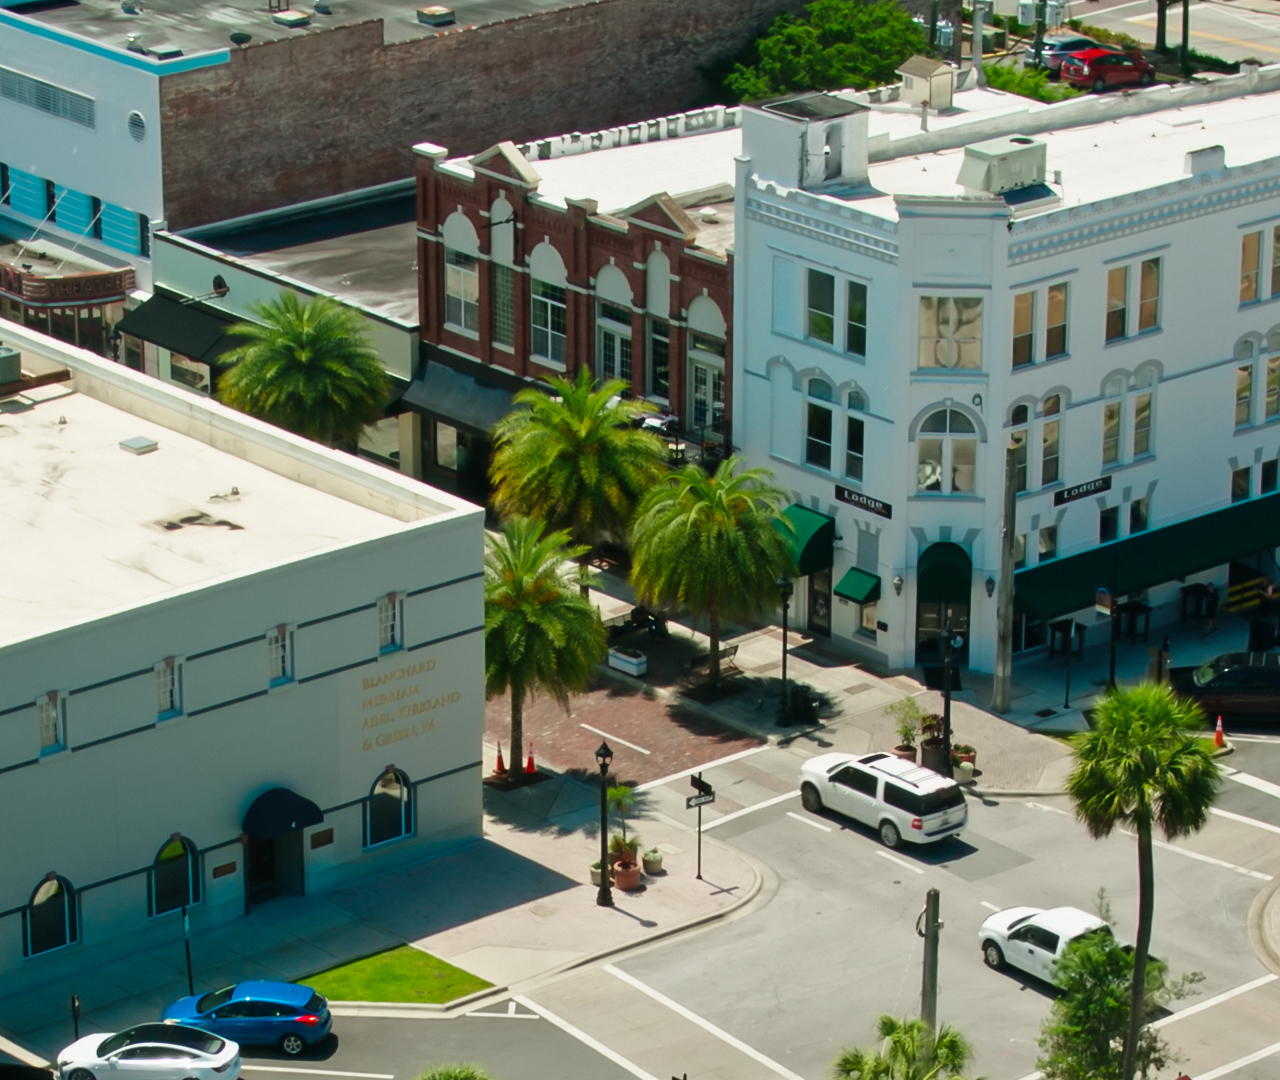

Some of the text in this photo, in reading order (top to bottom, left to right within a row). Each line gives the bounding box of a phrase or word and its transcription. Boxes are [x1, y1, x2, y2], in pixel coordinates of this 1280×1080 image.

[48, 273, 124, 297] THEATRE
[844, 489, 884, 509] Lodge
[1063, 478, 1104, 500] Lodge
[362, 659, 436, 691] BLANCHARD
[362, 684, 419, 711] MERRIAM
[398, 691, 460, 719] KIRKLAND
[362, 738, 373, 752] &
